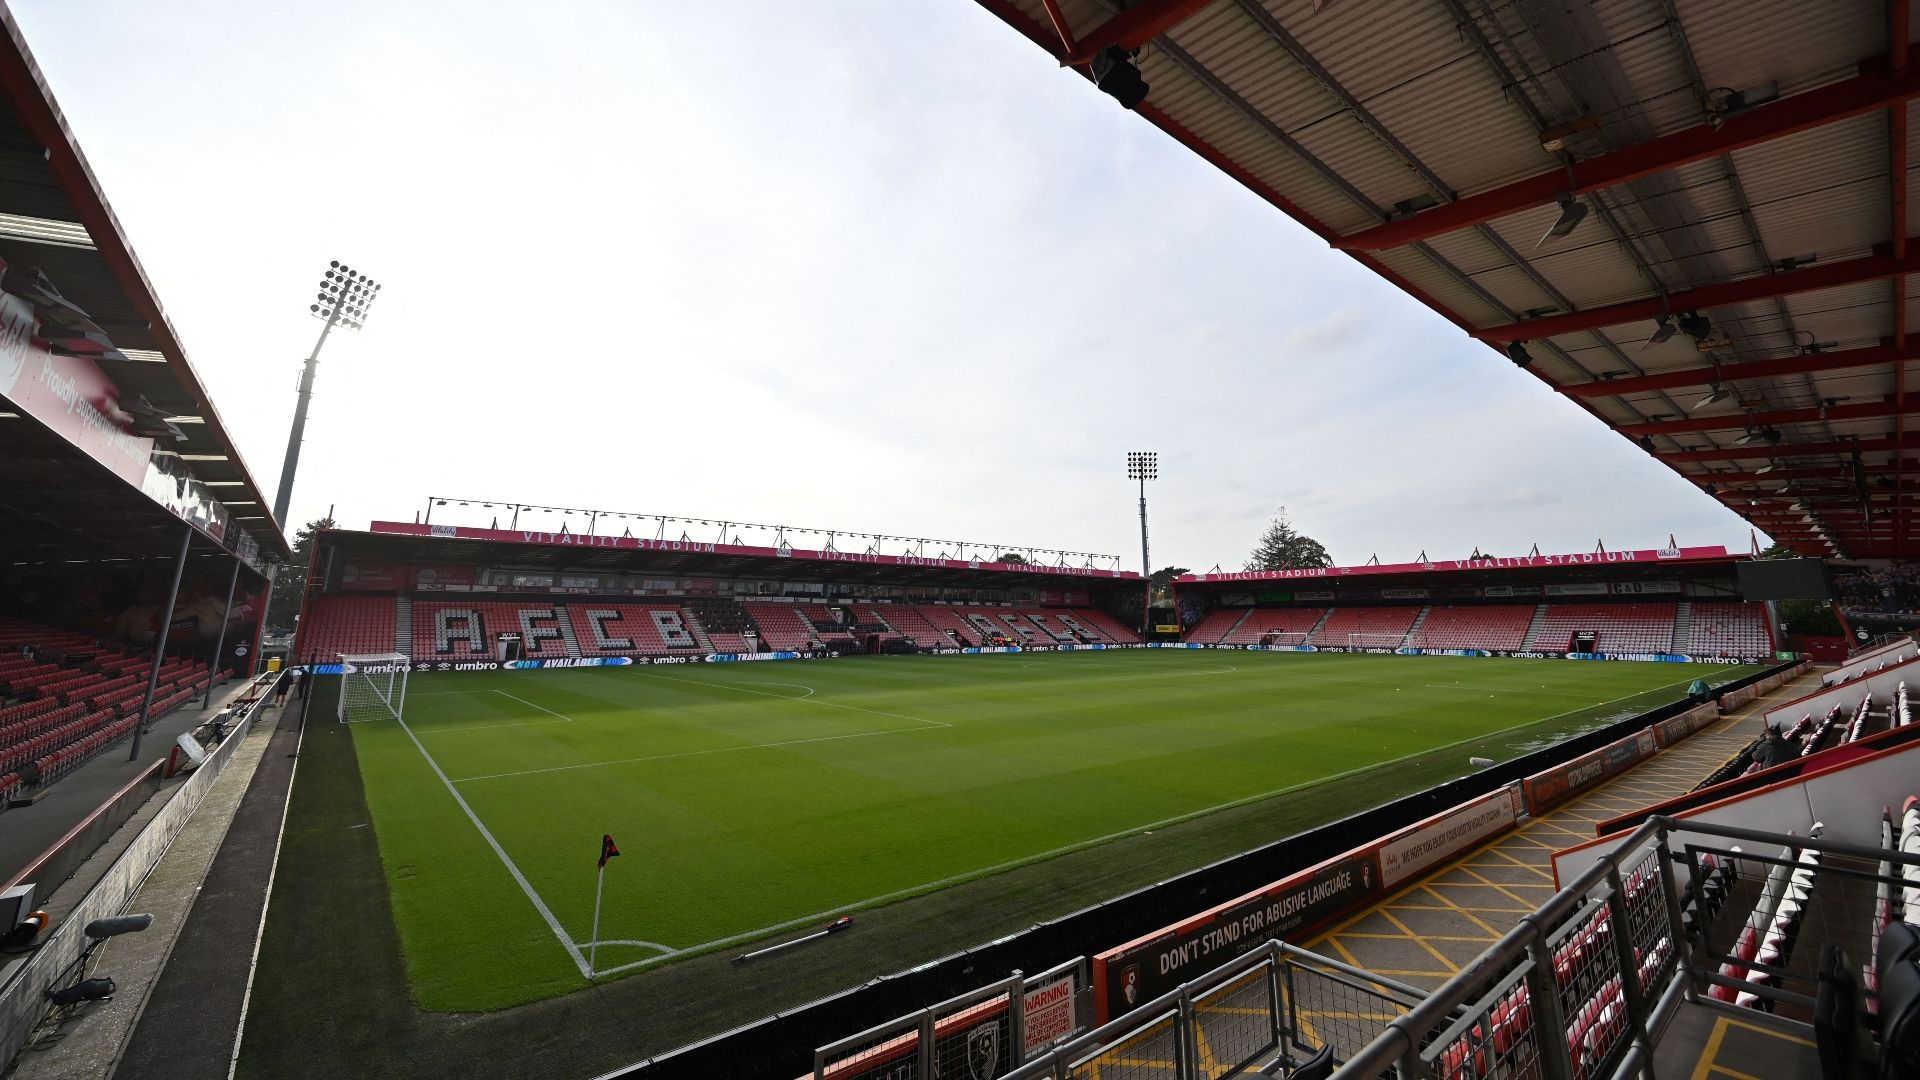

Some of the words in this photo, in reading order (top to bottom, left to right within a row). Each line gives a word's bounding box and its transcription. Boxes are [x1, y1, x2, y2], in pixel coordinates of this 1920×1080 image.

[40, 356, 78, 414] Proudly
[77, 396, 116, 446] supporting
[523, 532, 620, 546] VITALITY
[637, 538, 715, 552] STADIUM
[817, 551, 879, 563] VITALITY
[896, 556, 946, 567] STADIUM
[1455, 558, 1535, 569] VITALITY
[1545, 551, 1636, 565] STADIUM
[1006, 564, 1050, 573] VITALITY
[1055, 567, 1091, 575] STADIUM
[1216, 571, 1266, 581] VITALITY
[1271, 568, 1326, 578] STADIUM
[516, 660, 539, 669] NOW
[543, 658, 602, 668] AVAILABLE
[653, 656, 686, 664] umbro
[737, 652, 774, 661] TRAINING
[1511, 652, 1544, 660] umbro
[1604, 653, 1655, 661] TRAINING
[1696, 656, 1740, 665] umbro
[363, 664, 411, 674] umbro
[455, 662, 498, 672] umbro
[1410, 844, 1423, 859] HOPE
[1160, 939, 1198, 975] DON'T
[1202, 922, 1240, 955] STAND
[1243, 911, 1264, 937] FOR
[1266, 891, 1306, 925] ABUSIVE
[1307, 871, 1351, 904] LANGUAGE
[1025, 982, 1069, 1013] WARNING
[1024, 1018, 1029, 1027] IF
[1030, 1015, 1041, 1025] YOU
[1041, 1010, 1053, 1021] PASS
[1053, 1002, 1070, 1016] BEYOND
[1028, 1023, 1039, 1034] THIS
[1039, 1015, 1058, 1029] BARRIER
[1058, 1010, 1068, 1021] YOU
[1025, 1031, 1036, 1042] WILL
[1036, 1027, 1044, 1036] BE
[1044, 1016, 1070, 1033] COMMITTING
[1025, 1040, 1030, 1049] A
[1052, 1023, 1070, 1038] OFFENCE
